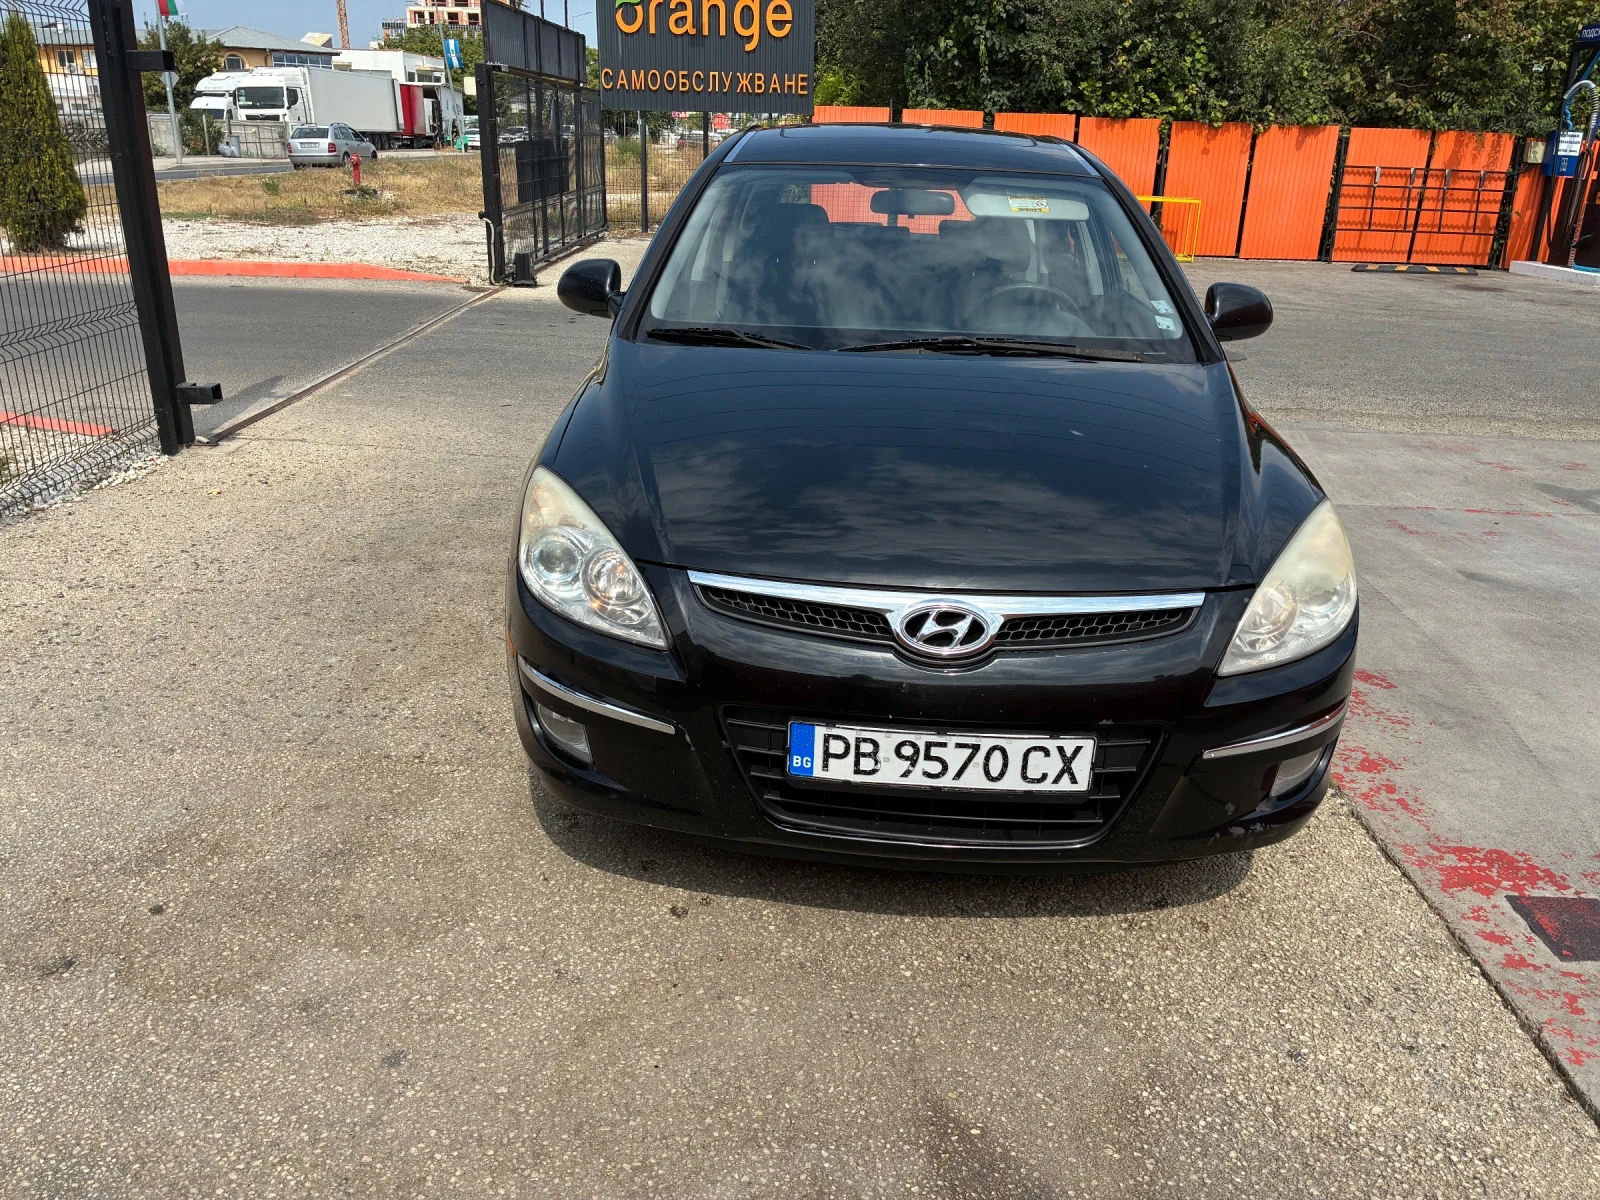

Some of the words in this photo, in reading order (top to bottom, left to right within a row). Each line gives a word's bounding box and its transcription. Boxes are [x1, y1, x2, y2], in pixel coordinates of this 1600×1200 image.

[601, 68, 808, 95] САМООБСЛУЖВАНЕ
[792, 755, 812, 769] BG
[821, 733, 882, 776] PB
[894, 740, 1010, 783] 9570
[1020, 745, 1084, 785] CX
